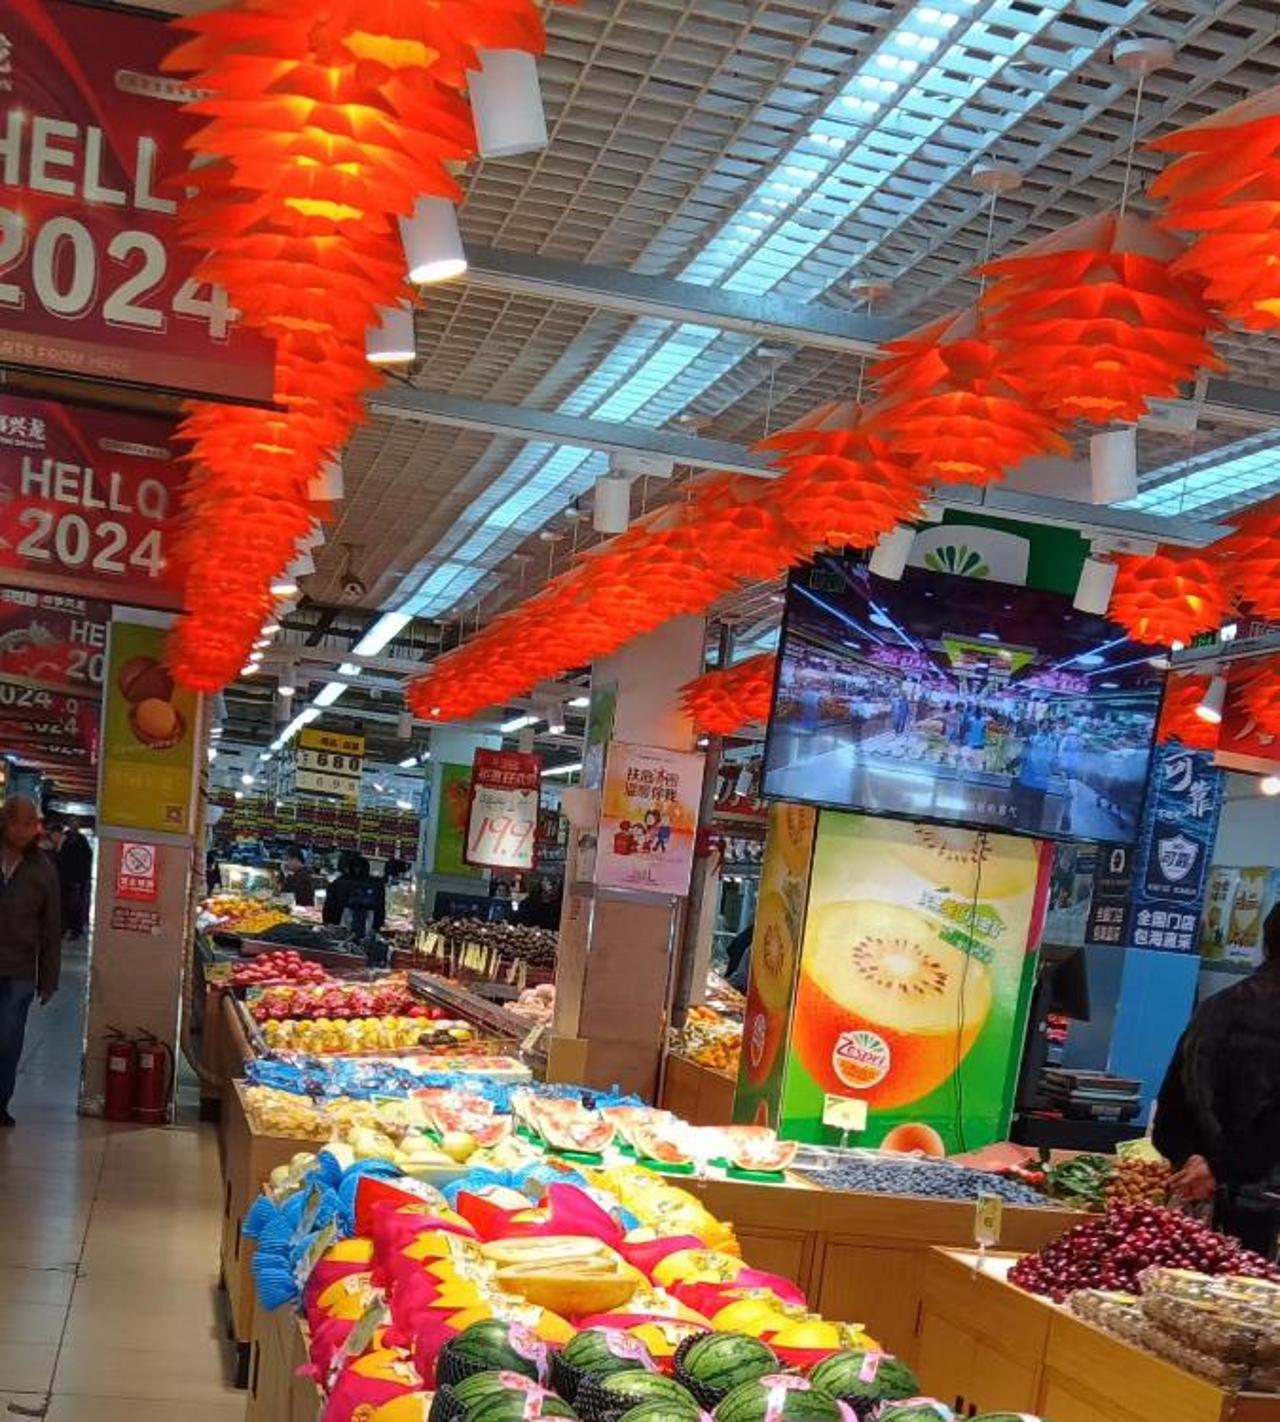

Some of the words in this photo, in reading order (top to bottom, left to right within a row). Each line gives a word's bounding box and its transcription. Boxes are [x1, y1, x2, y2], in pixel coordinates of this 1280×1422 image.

[16, 508, 167, 577] 2024
[1136, 909, 1197, 932] 全国门店
[836, 1036, 886, 1066] Zespri
